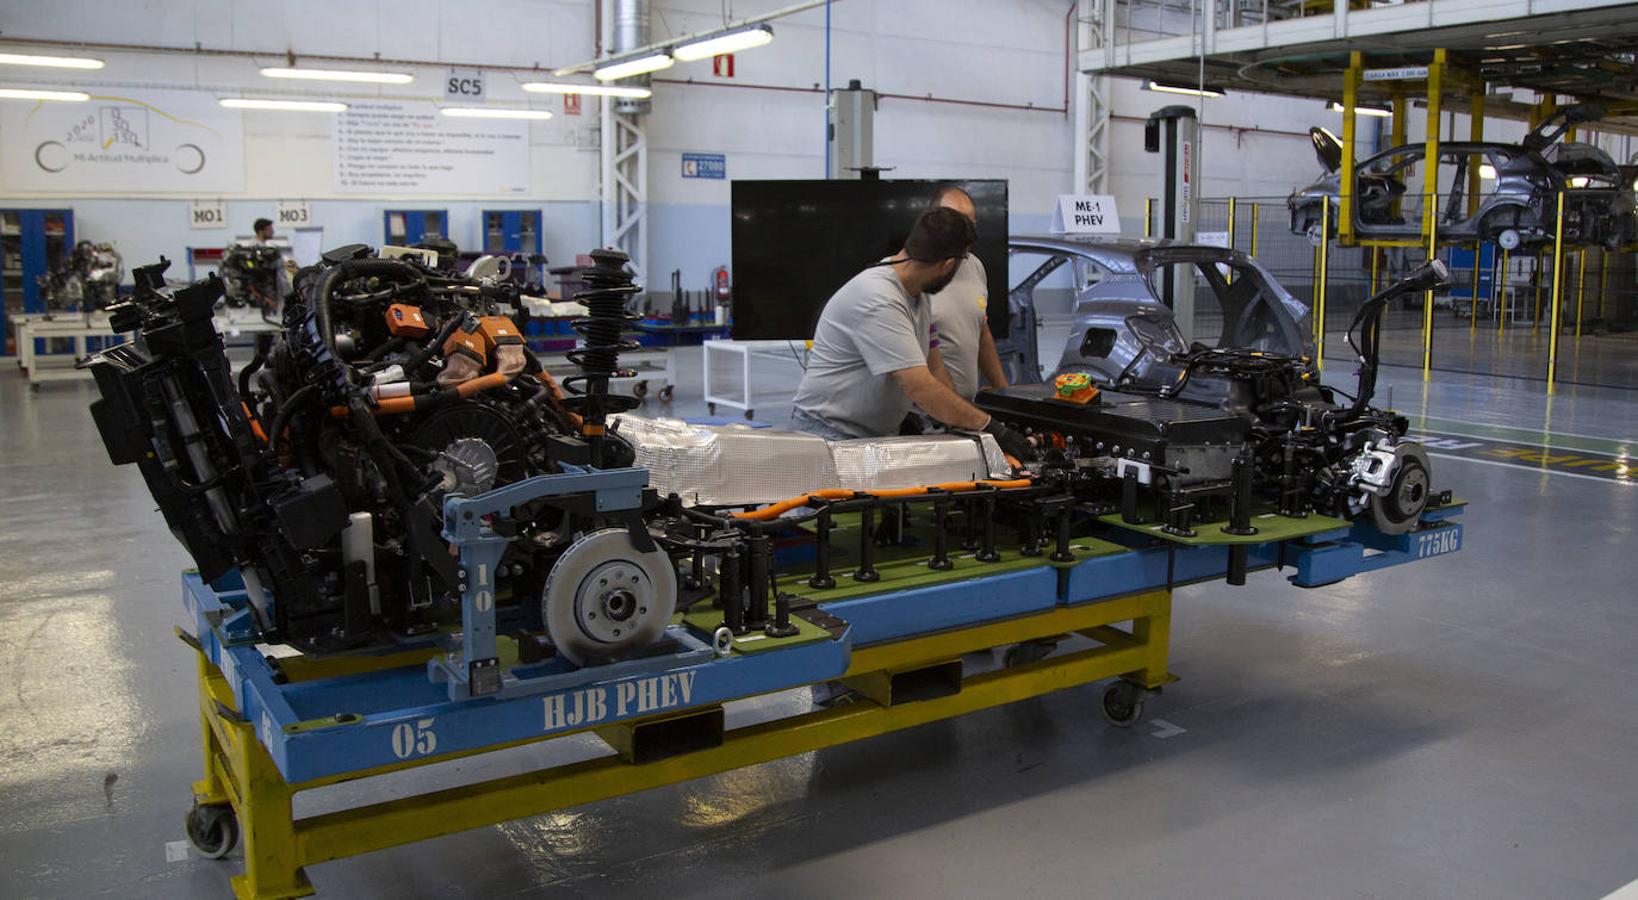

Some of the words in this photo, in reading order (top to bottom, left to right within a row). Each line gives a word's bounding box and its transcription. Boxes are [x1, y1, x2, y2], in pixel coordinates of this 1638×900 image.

[448, 77, 482, 96] SC5
[1075, 201, 1100, 212] ME-1
[194, 209, 222, 222] MO1
[280, 208, 308, 222] MO3
[1074, 214, 1104, 226] PHEV
[1418, 529, 1458, 558] 775KG
[543, 688, 607, 731] HJB
[616, 670, 697, 717] PHEV
[392, 717, 438, 759] 05
